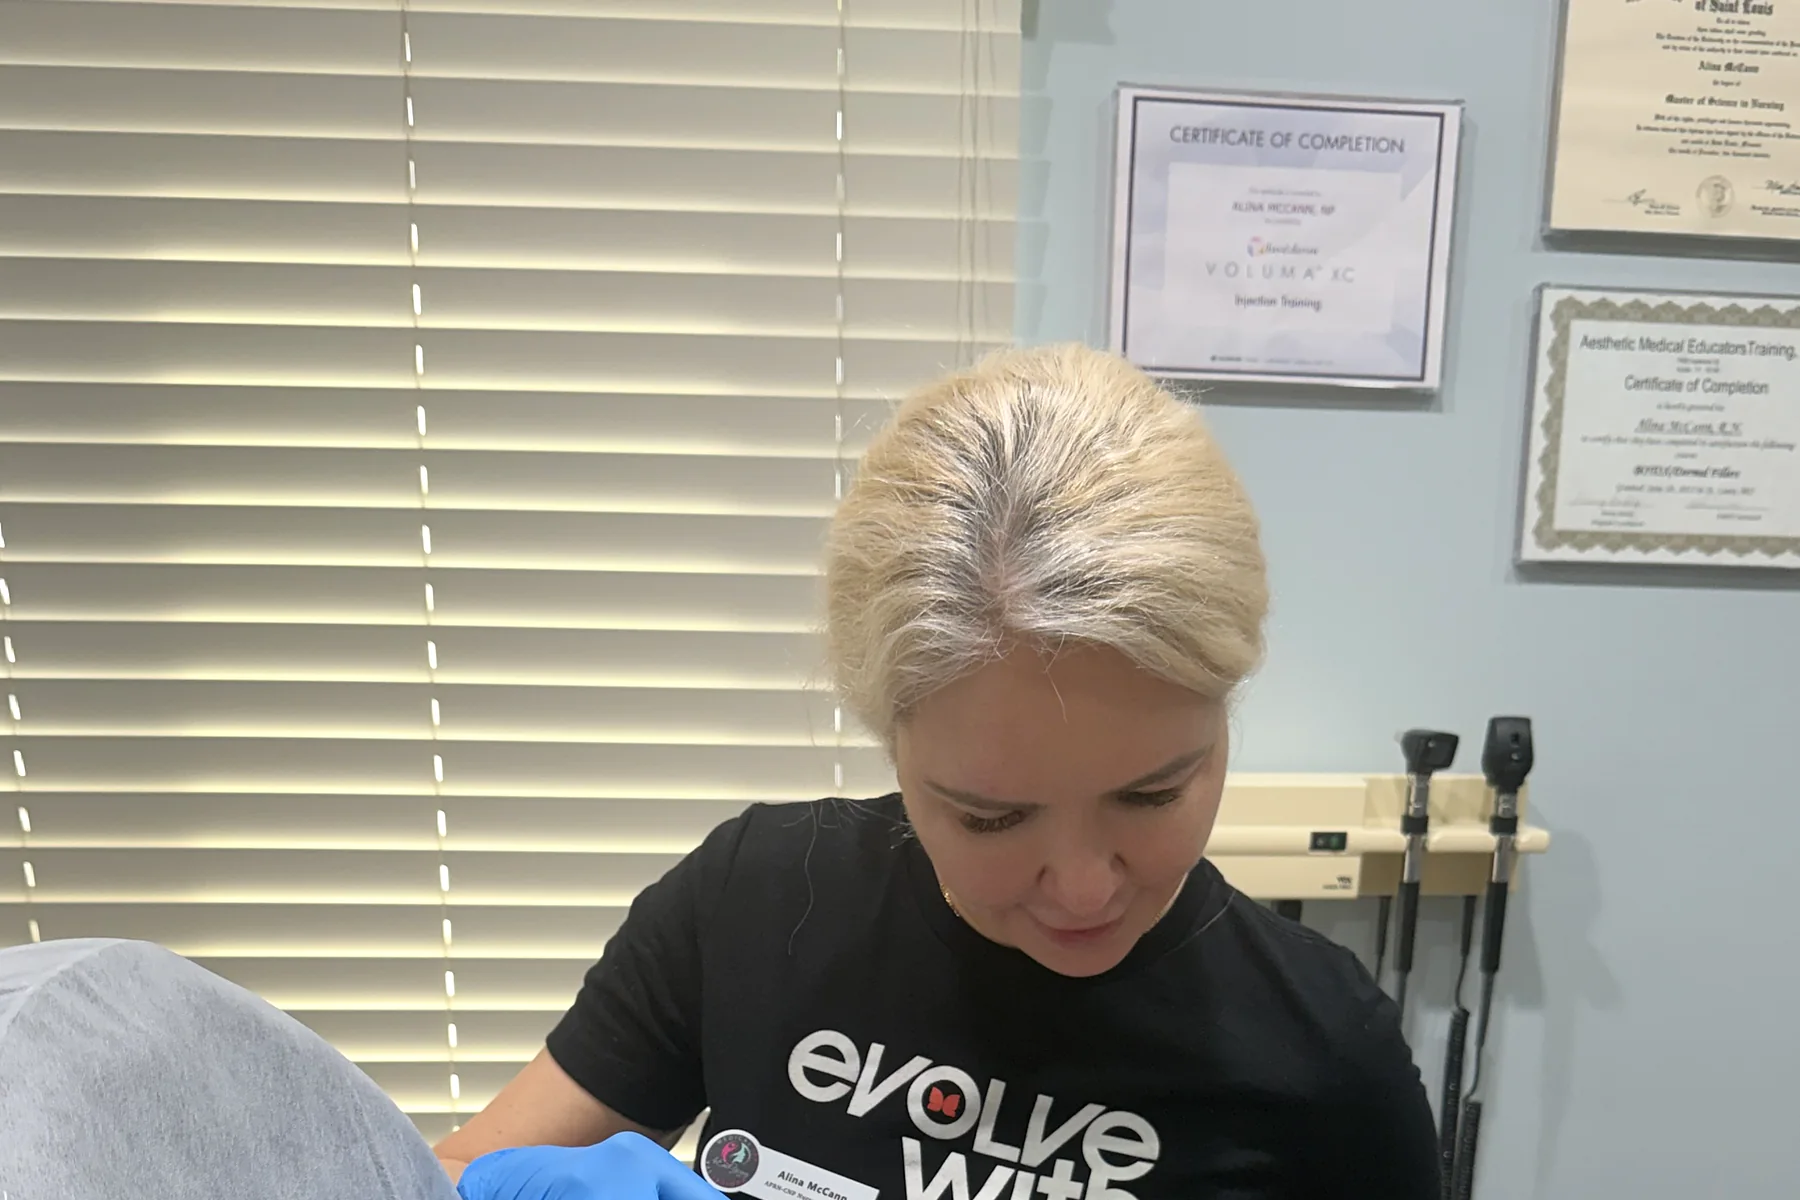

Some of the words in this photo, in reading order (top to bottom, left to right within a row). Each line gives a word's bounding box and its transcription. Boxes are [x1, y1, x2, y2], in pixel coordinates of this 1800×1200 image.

[1169, 125, 1264, 148] CERTIFICATE
[1270, 131, 1294, 149] OF
[1298, 132, 1405, 154] COMPLETION
[1234, 294, 1277, 309] Injection
[1281, 294, 1322, 313] Training
[1580, 334, 1635, 351] Aesthetic
[1638, 336, 1685, 353] Medical
[1624, 374, 1684, 393] Certificate
[1686, 378, 1700, 392] of
[1702, 378, 1769, 396] Completion
[777, 1170, 804, 1188] Alina
[764, 1180, 797, 1198] APRN-CNP
